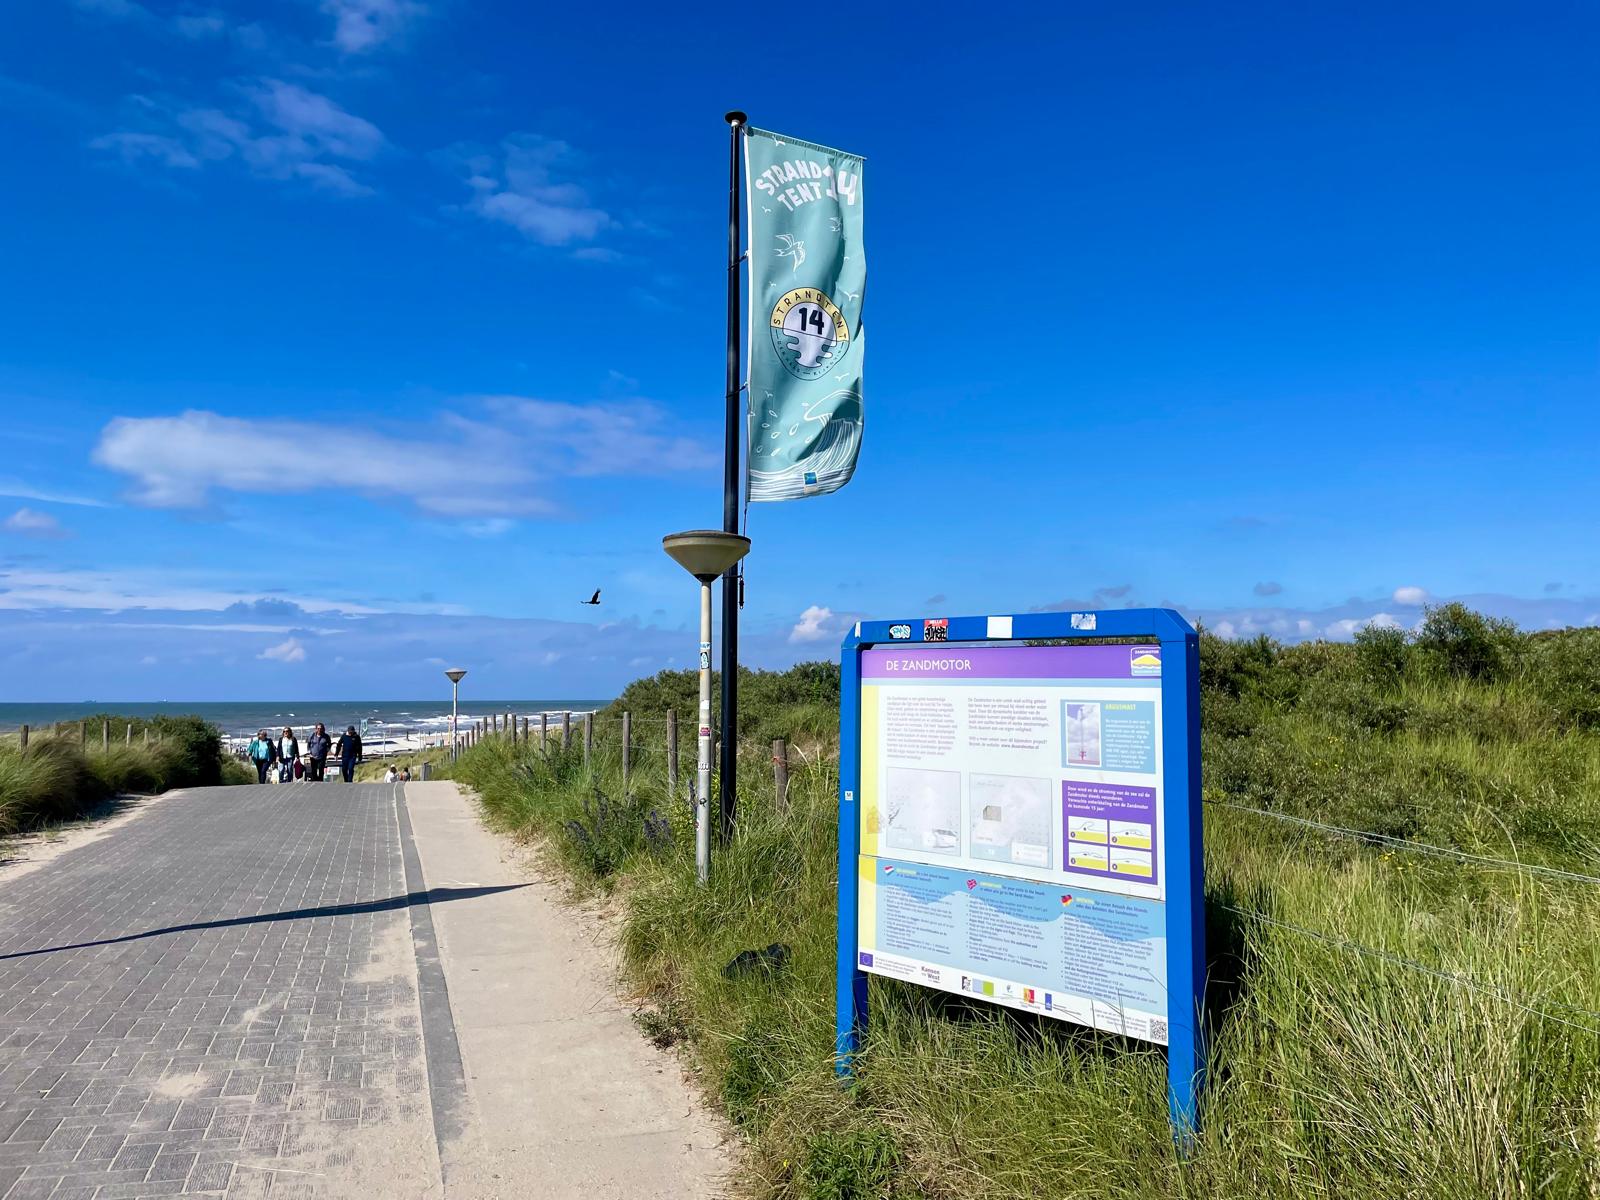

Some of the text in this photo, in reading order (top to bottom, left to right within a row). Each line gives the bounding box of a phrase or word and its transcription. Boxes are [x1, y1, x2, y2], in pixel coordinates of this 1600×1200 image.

[755, 160, 822, 196] STRAND
[777, 181, 822, 212] TENT
[773, 290, 847, 341] STRANDTENT
[798, 307, 825, 335] 14
[886, 659, 972, 671] DE ZANDMOTOR
